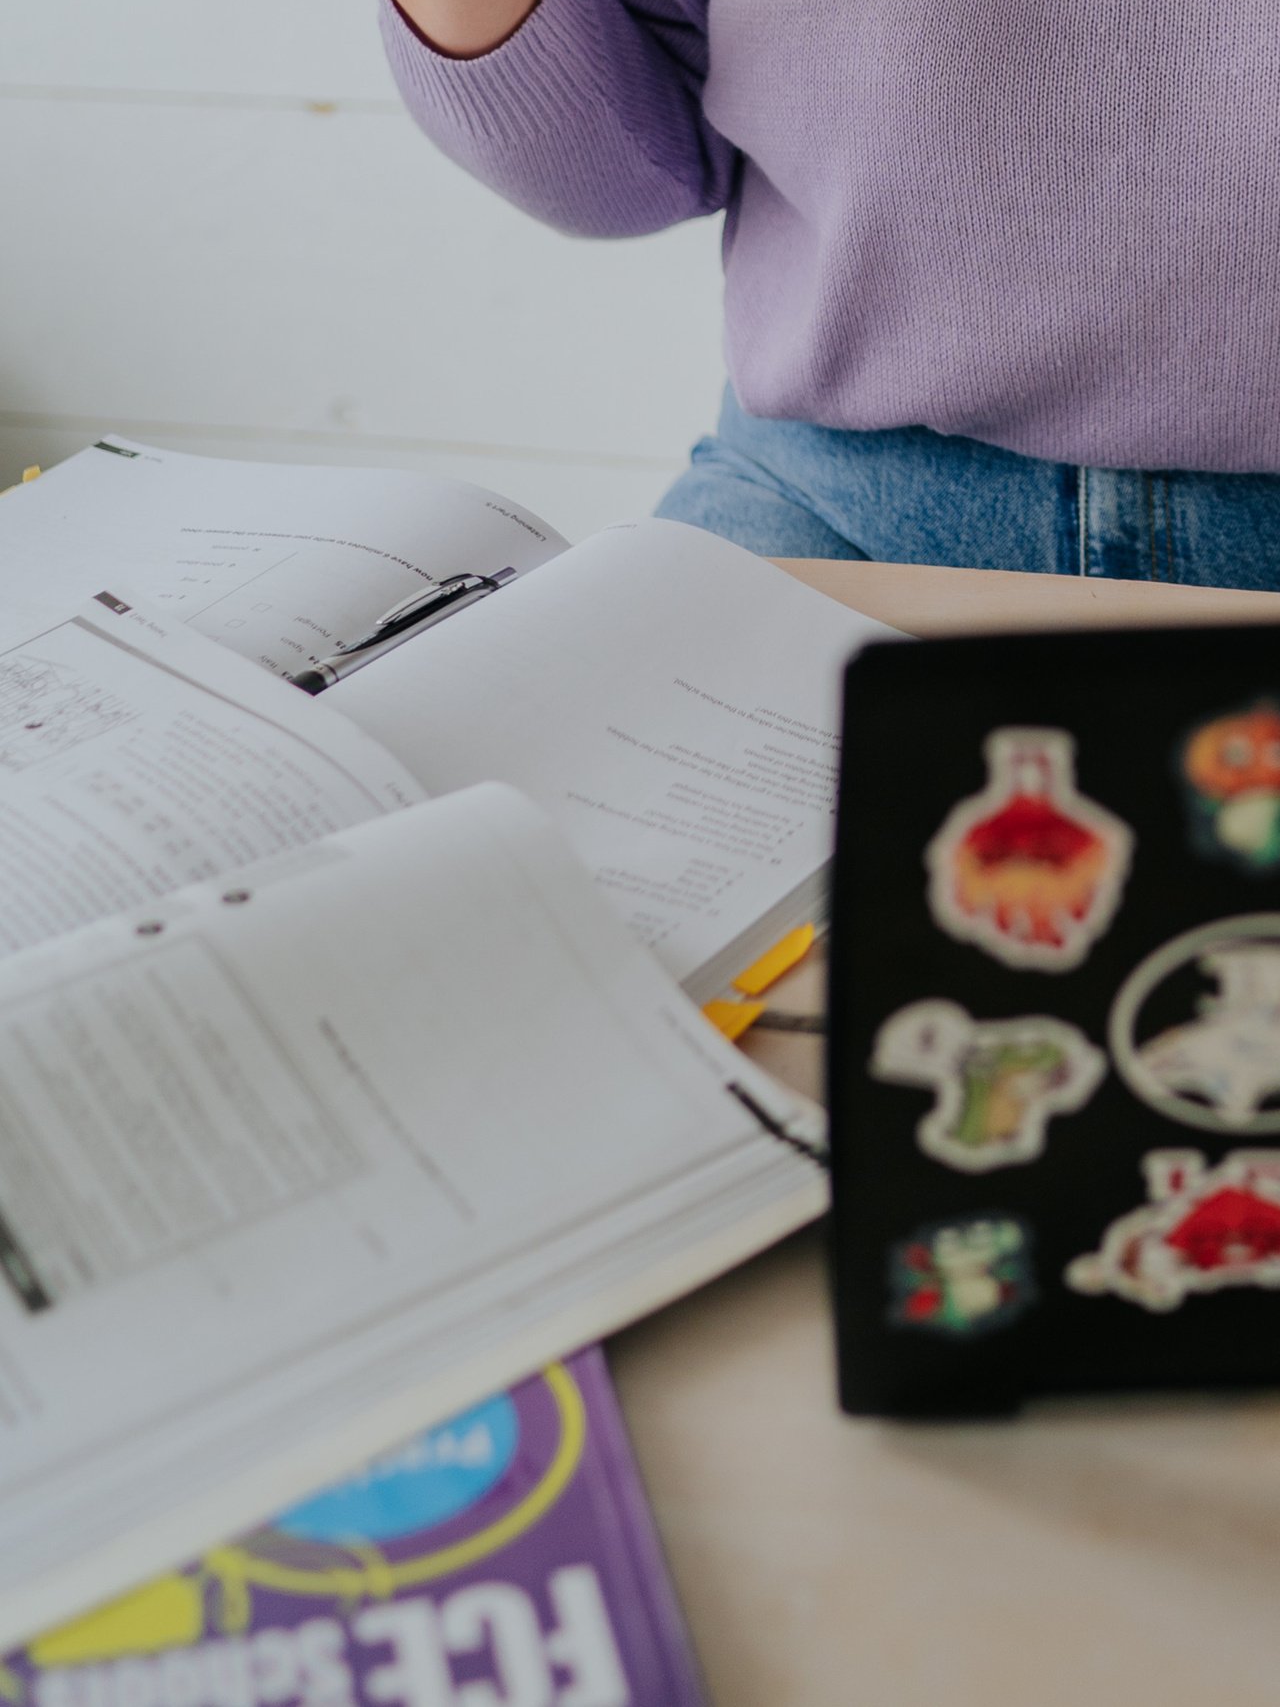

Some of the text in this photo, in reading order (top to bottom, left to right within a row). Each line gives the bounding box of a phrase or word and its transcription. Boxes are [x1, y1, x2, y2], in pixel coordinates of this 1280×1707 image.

[492, 505, 511, 517] Part
[510, 515, 547, 543] Listening
[347, 542, 384, 555] minutes
[391, 556, 413, 570] have
[413, 567, 434, 582] now
[293, 615, 332, 638] Portugal
[280, 636, 306, 653] Spain
[258, 655, 278, 669] Italy
[700, 693, 724, 708] whole
[724, 704, 737, 714] the
[747, 713, 774, 729] talking
[777, 715, 792, 725] this
[792, 720, 818, 733] school
